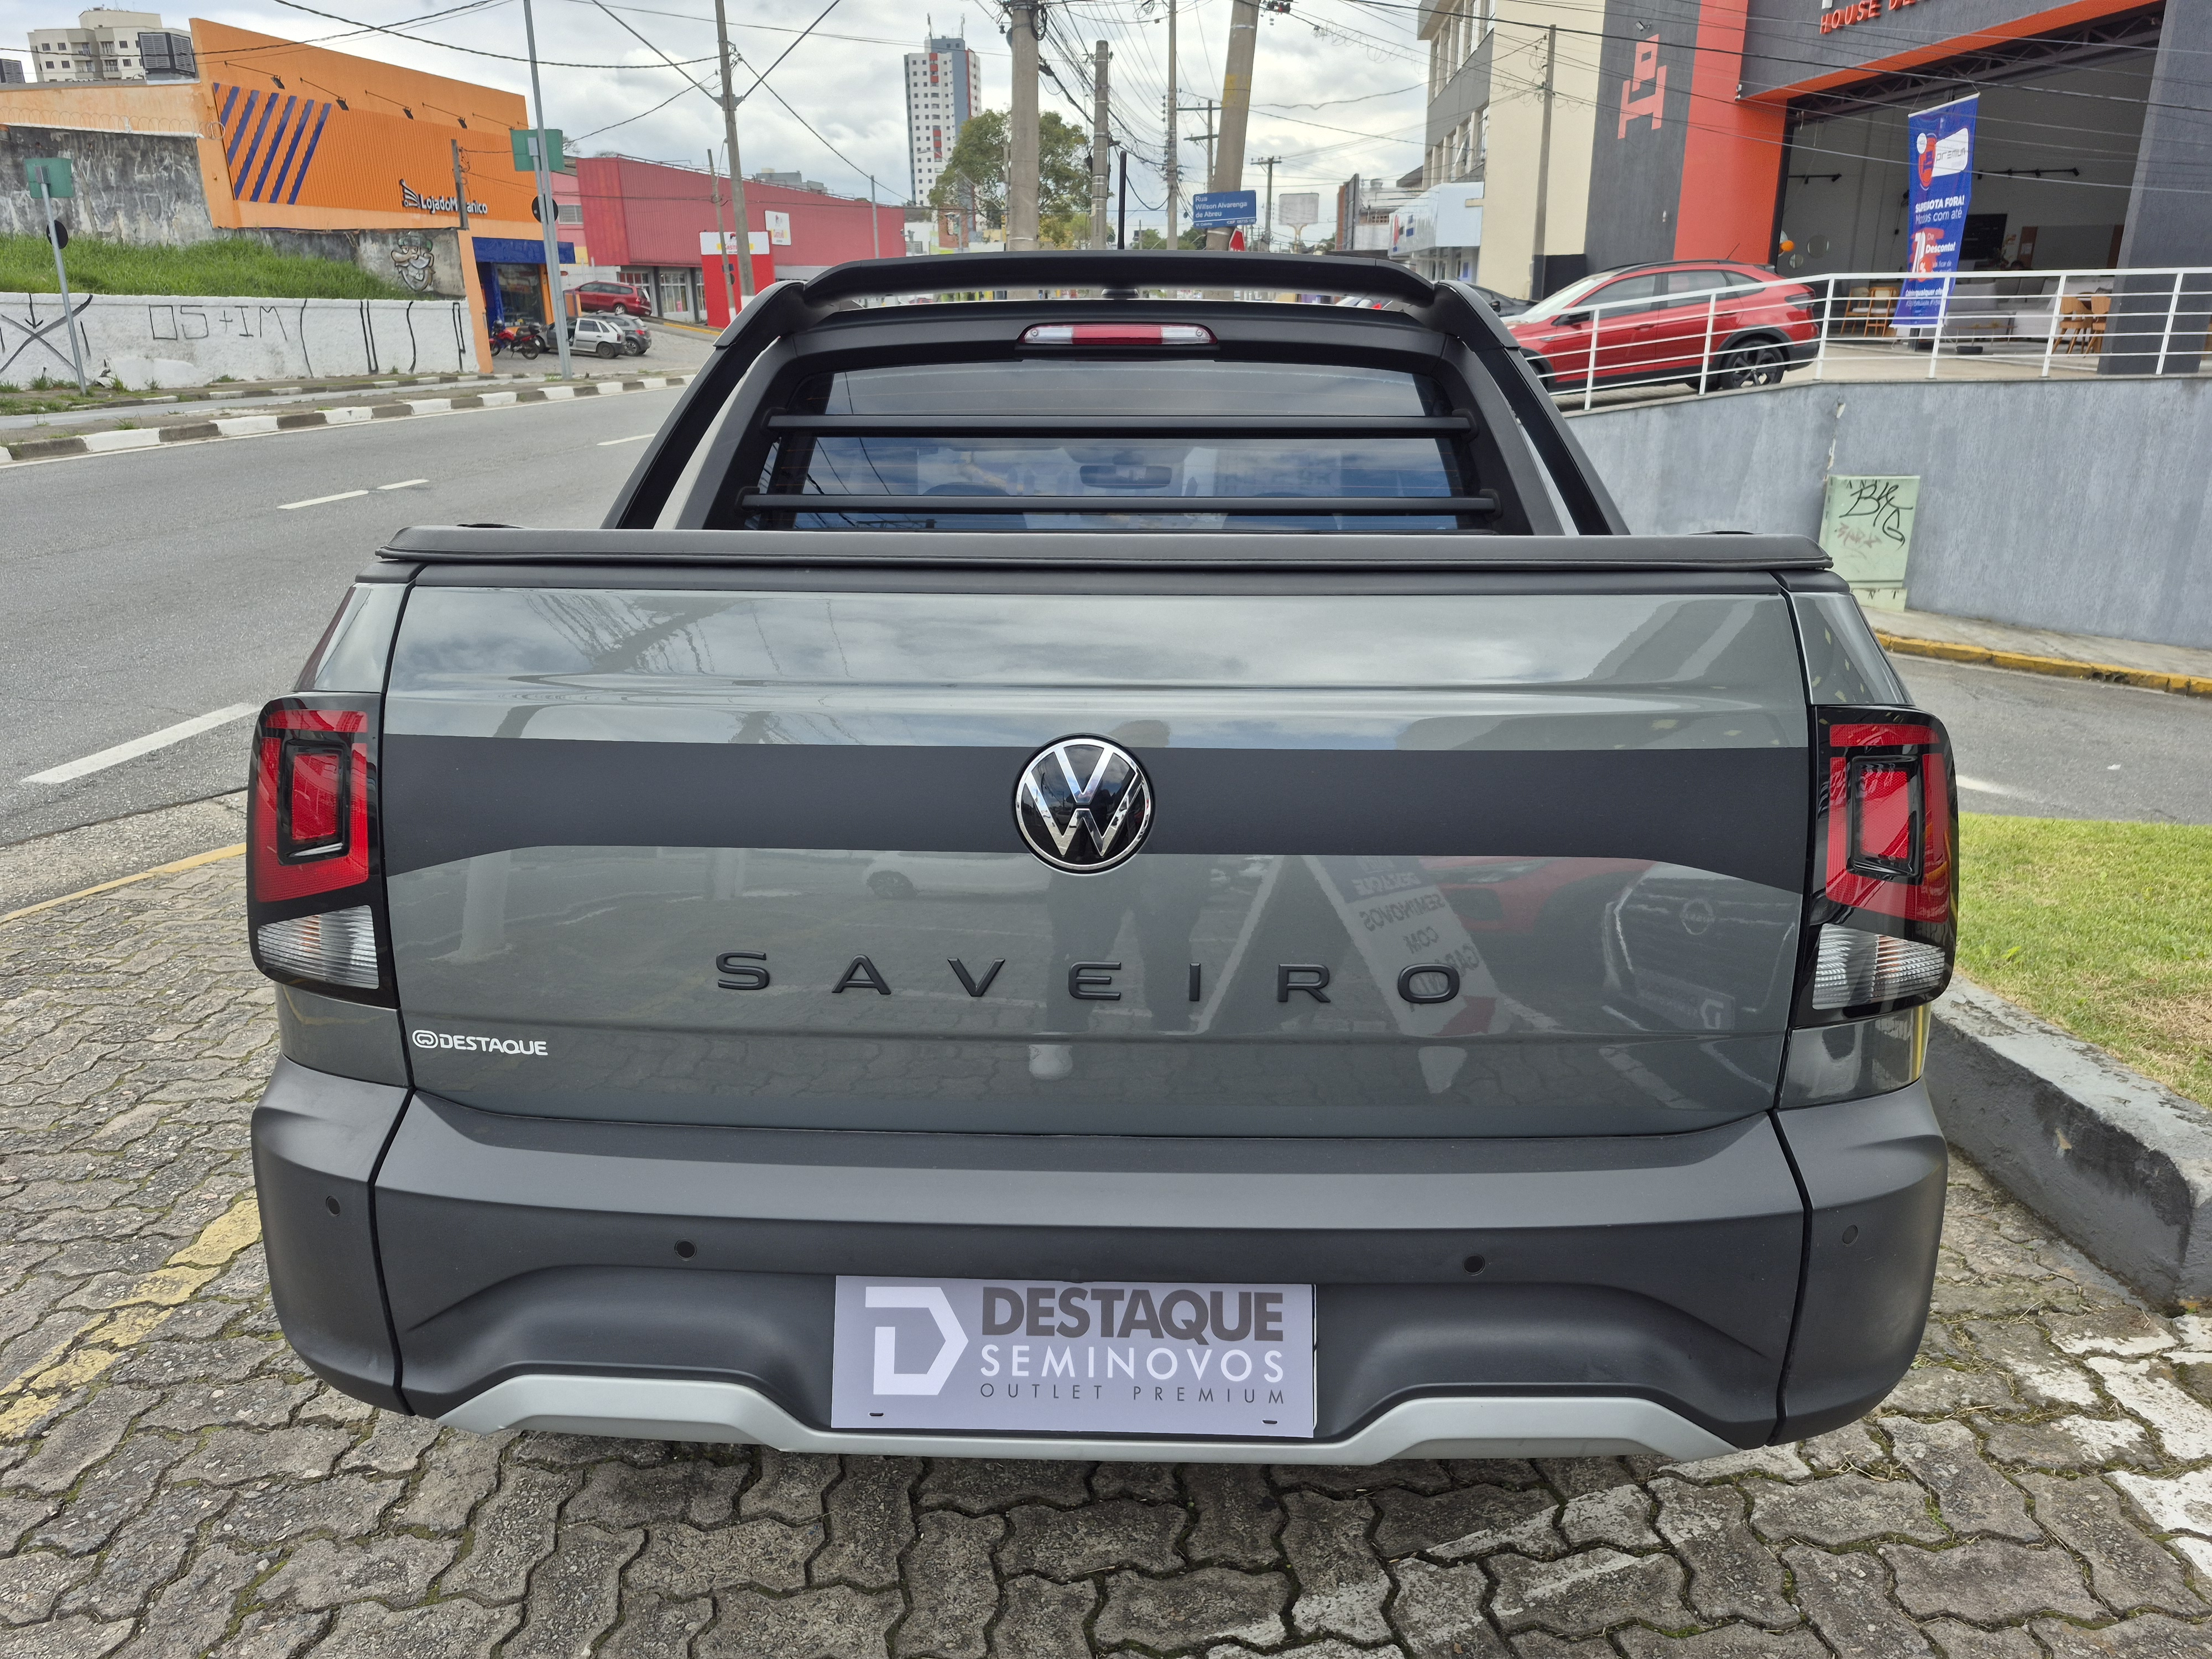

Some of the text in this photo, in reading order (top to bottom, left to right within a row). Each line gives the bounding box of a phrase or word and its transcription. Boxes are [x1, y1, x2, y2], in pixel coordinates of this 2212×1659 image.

[1820, 0, 1881, 34] HOUSE
[1944, 195, 1965, 208] FORA!
[1933, 211, 1949, 222] com
[1951, 206, 1963, 220] até
[1925, 241, 1956, 254] Desconto!
[716, 950, 1460, 1005] SAVEIRO
[439, 1034, 548, 1056] DESTAQUE
[982, 1286, 1284, 1345] DESTAQUE
[980, 1344, 1284, 1383] SEMINOVOS
[980, 1383, 1284, 1404] OUTLET PREMIUM
